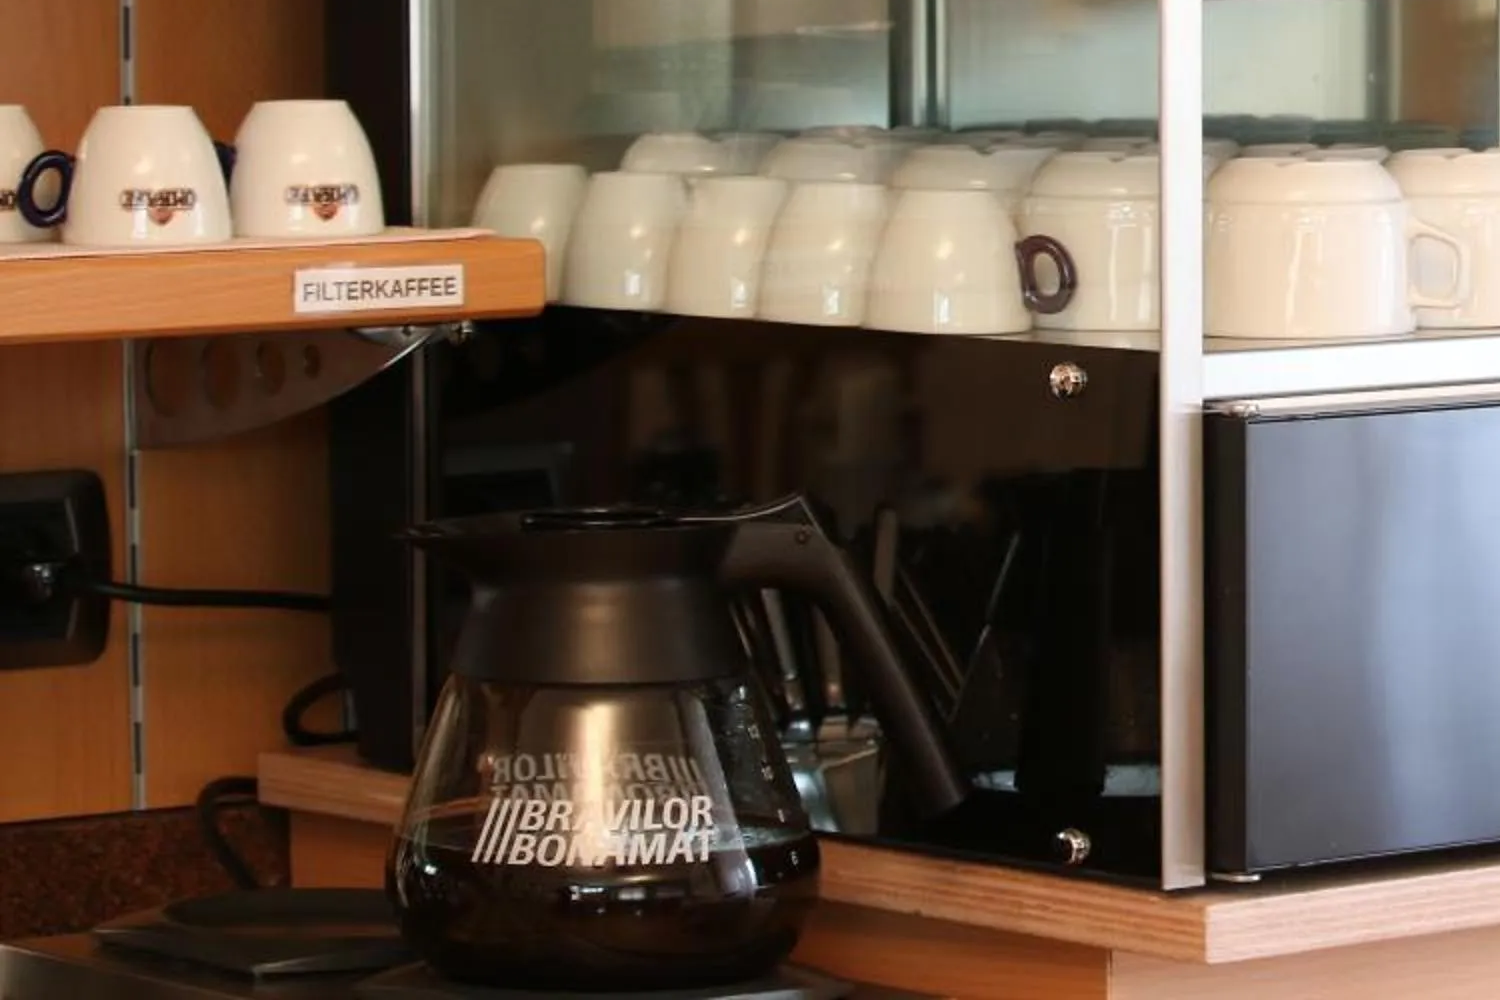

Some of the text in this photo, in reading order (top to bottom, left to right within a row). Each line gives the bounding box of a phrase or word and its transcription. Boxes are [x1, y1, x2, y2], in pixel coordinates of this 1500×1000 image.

[302, 275, 458, 302] FILTERKAFFEE
[519, 796, 714, 832] BRAVILOR
[507, 828, 717, 867] BONAMAT
